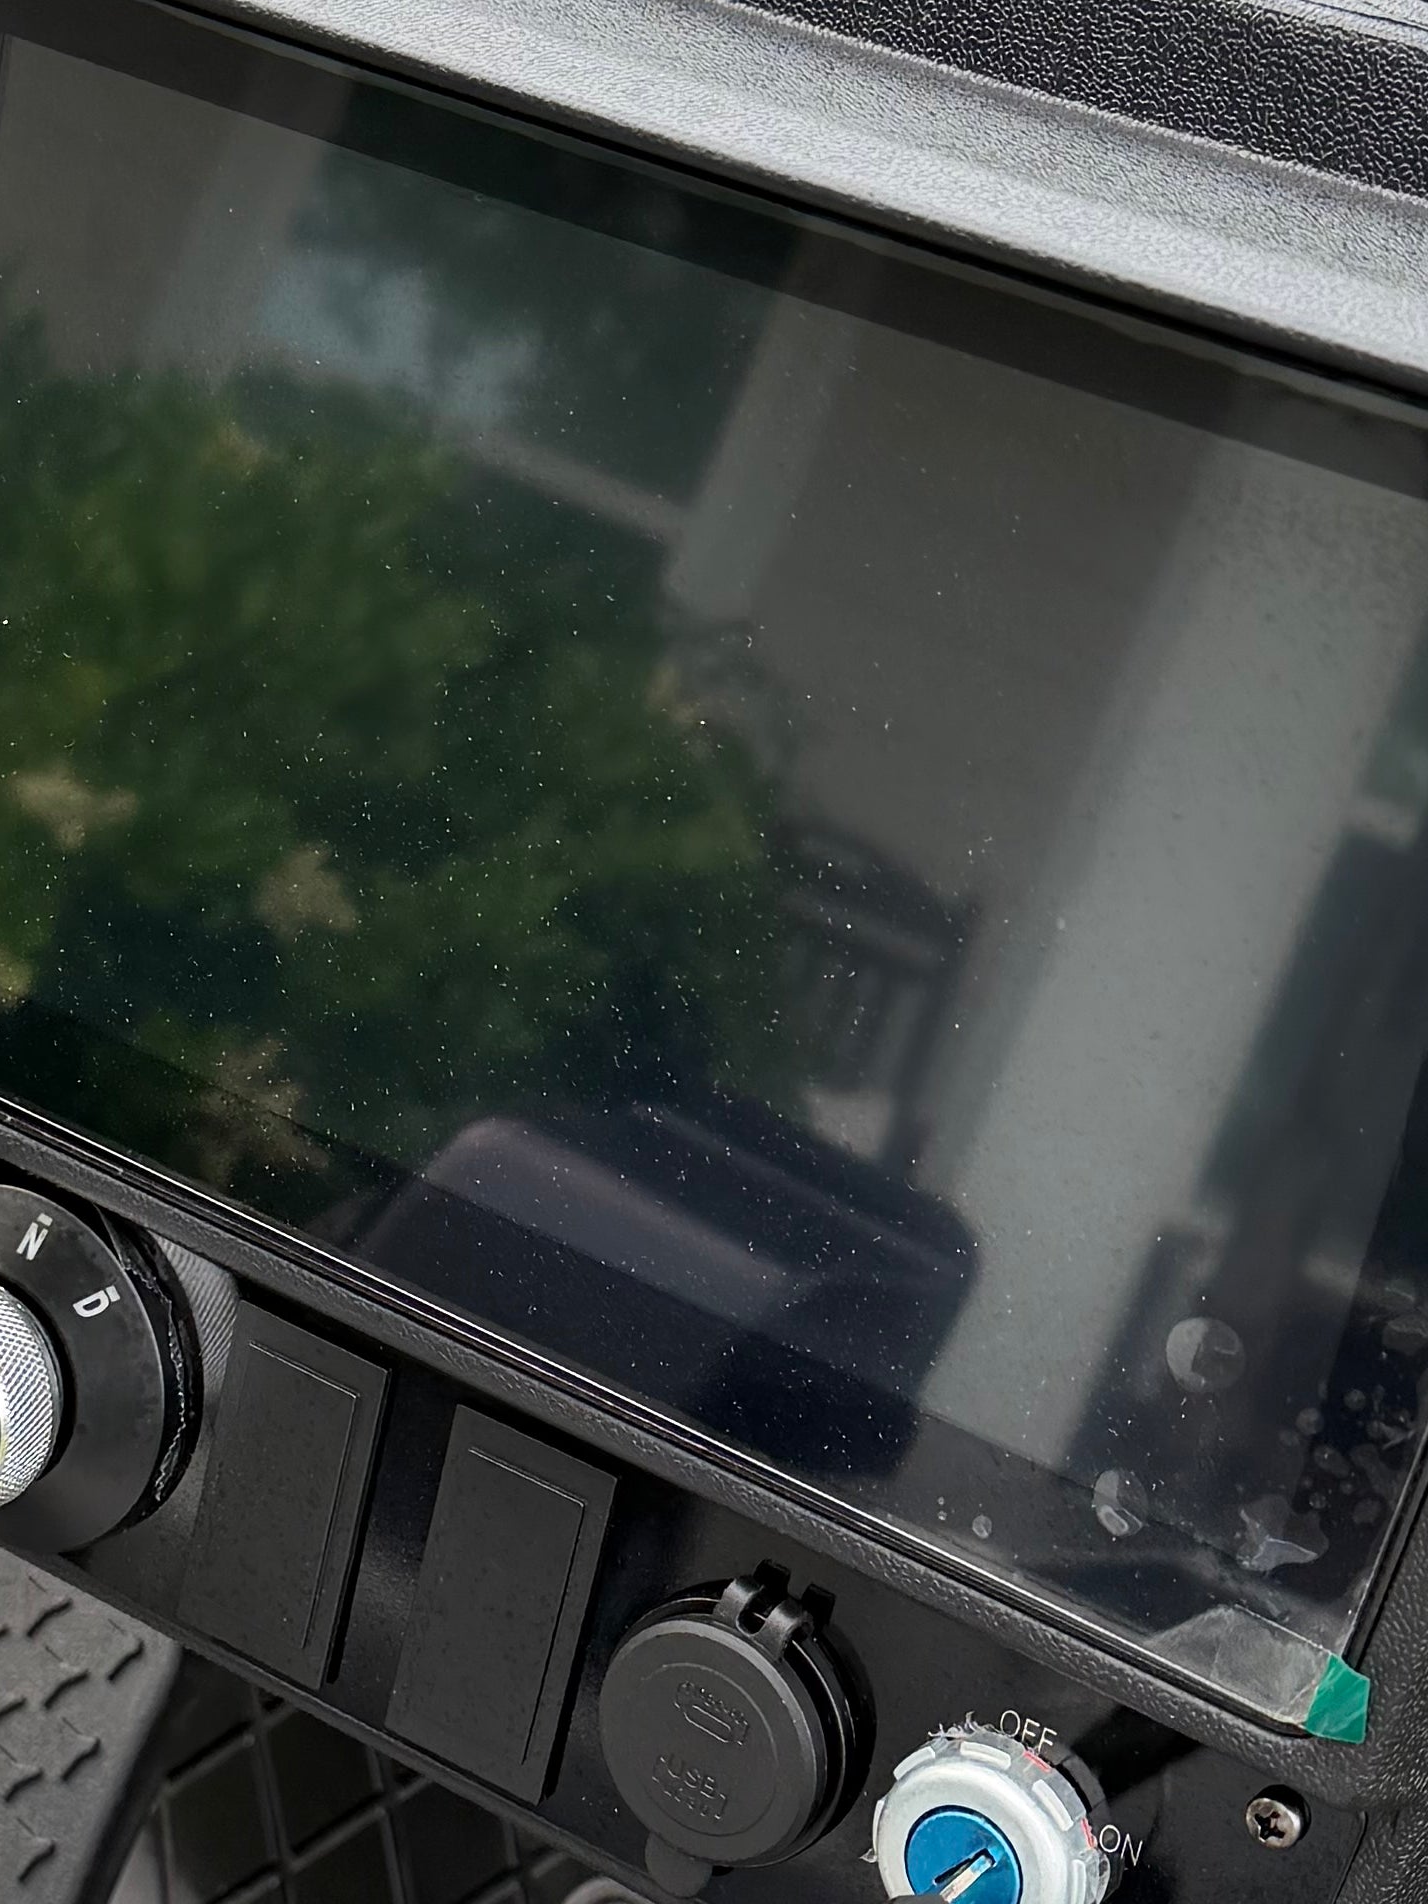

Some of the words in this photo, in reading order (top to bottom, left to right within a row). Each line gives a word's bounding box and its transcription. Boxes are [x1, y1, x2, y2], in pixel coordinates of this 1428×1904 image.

[15, 1221, 50, 1261] N
[72, 1289, 110, 1318] D
[999, 1709, 1058, 1753] OFF
[1099, 1824, 1144, 1867] ON
